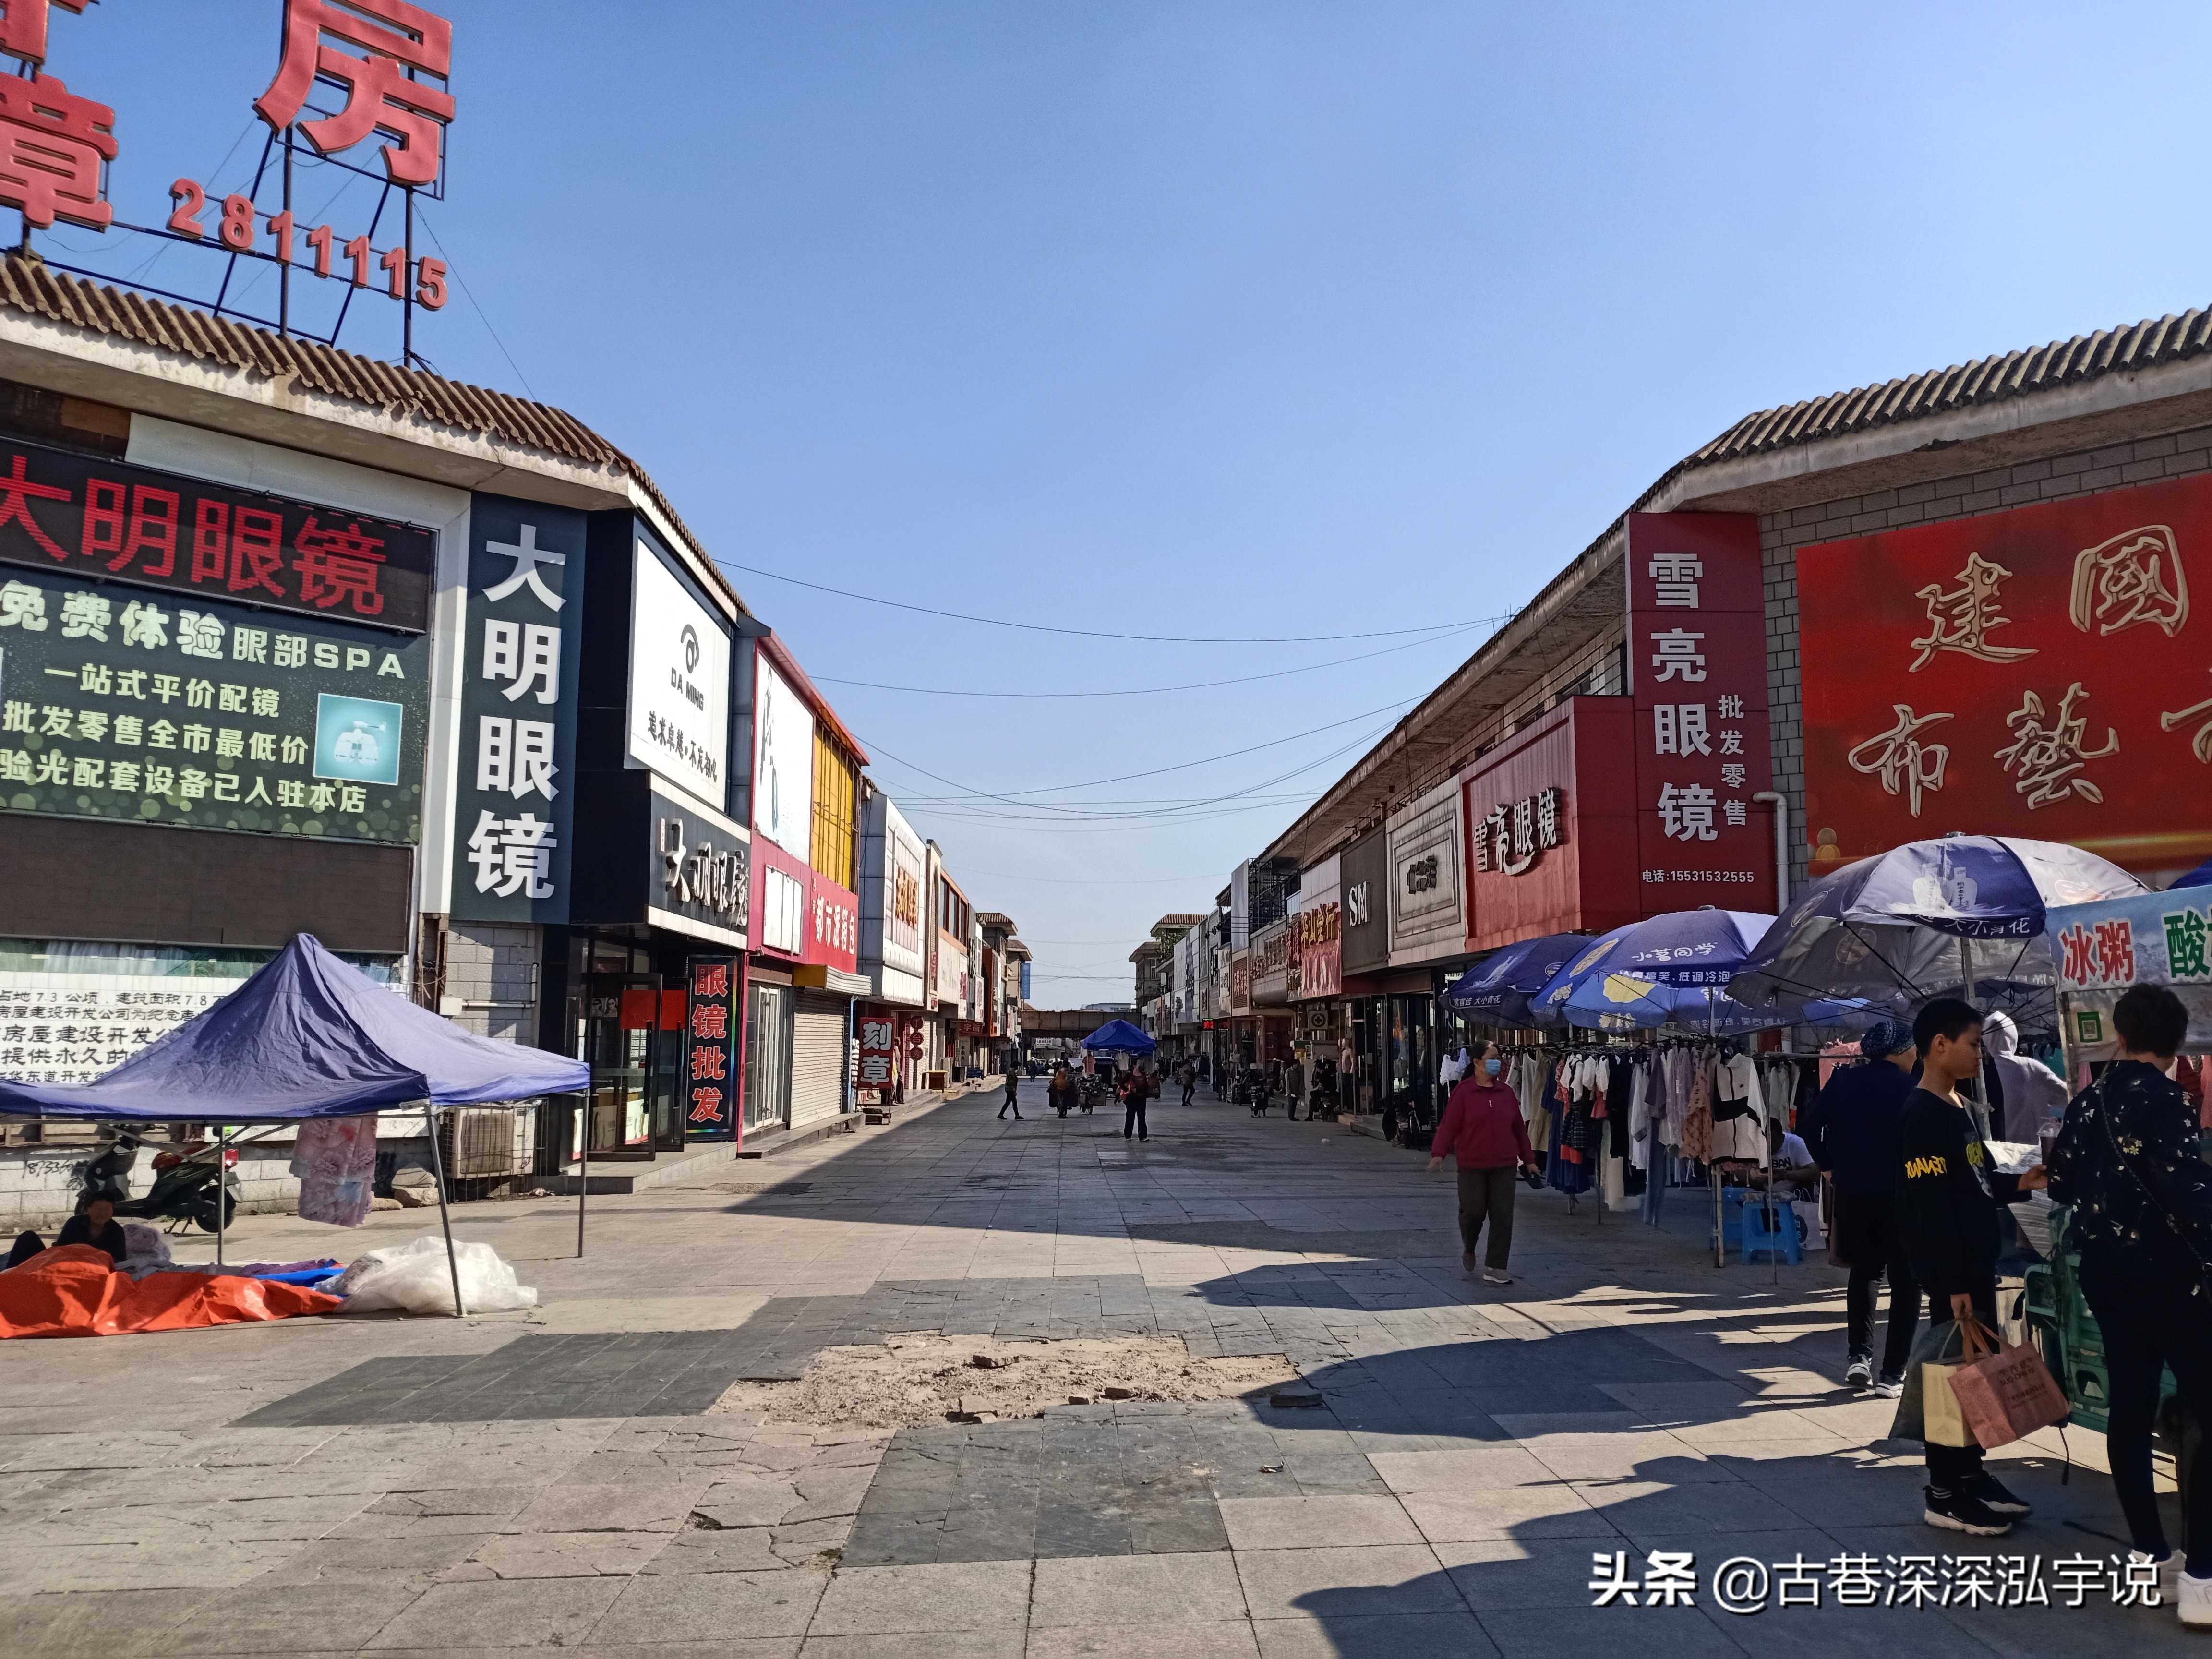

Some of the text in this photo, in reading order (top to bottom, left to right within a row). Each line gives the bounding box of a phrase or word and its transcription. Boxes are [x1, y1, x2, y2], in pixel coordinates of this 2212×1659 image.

[167, 179, 448, 311] 2811115
[0, 455, 387, 615] 大明眼镜
[44, 662, 281, 718] 一站式平价配镜
[468, 524, 567, 899] 大明眼镜
[671, 667, 704, 711] DA MING
[1649, 553, 1718, 841] 雪亮眼镜
[3, 700, 309, 765] 批发零售全市最低价
[1718, 695, 1746, 825] 批发零售
[0, 748, 367, 813] 验光配套设备已入驻本店
[1474, 788, 1557, 876] 雪亮眼镜
[1632, 942, 1718, 962] 小茗同学
[2061, 909, 2212, 986] 冰粥 酸
[0, 1005, 204, 1021] 房屋建设开发公司为纪念唐
[689, 964, 728, 1122] 眼镜批发
[0, 1047, 140, 1066] 提供永久的
[860, 1021, 892, 1085] 刻章
